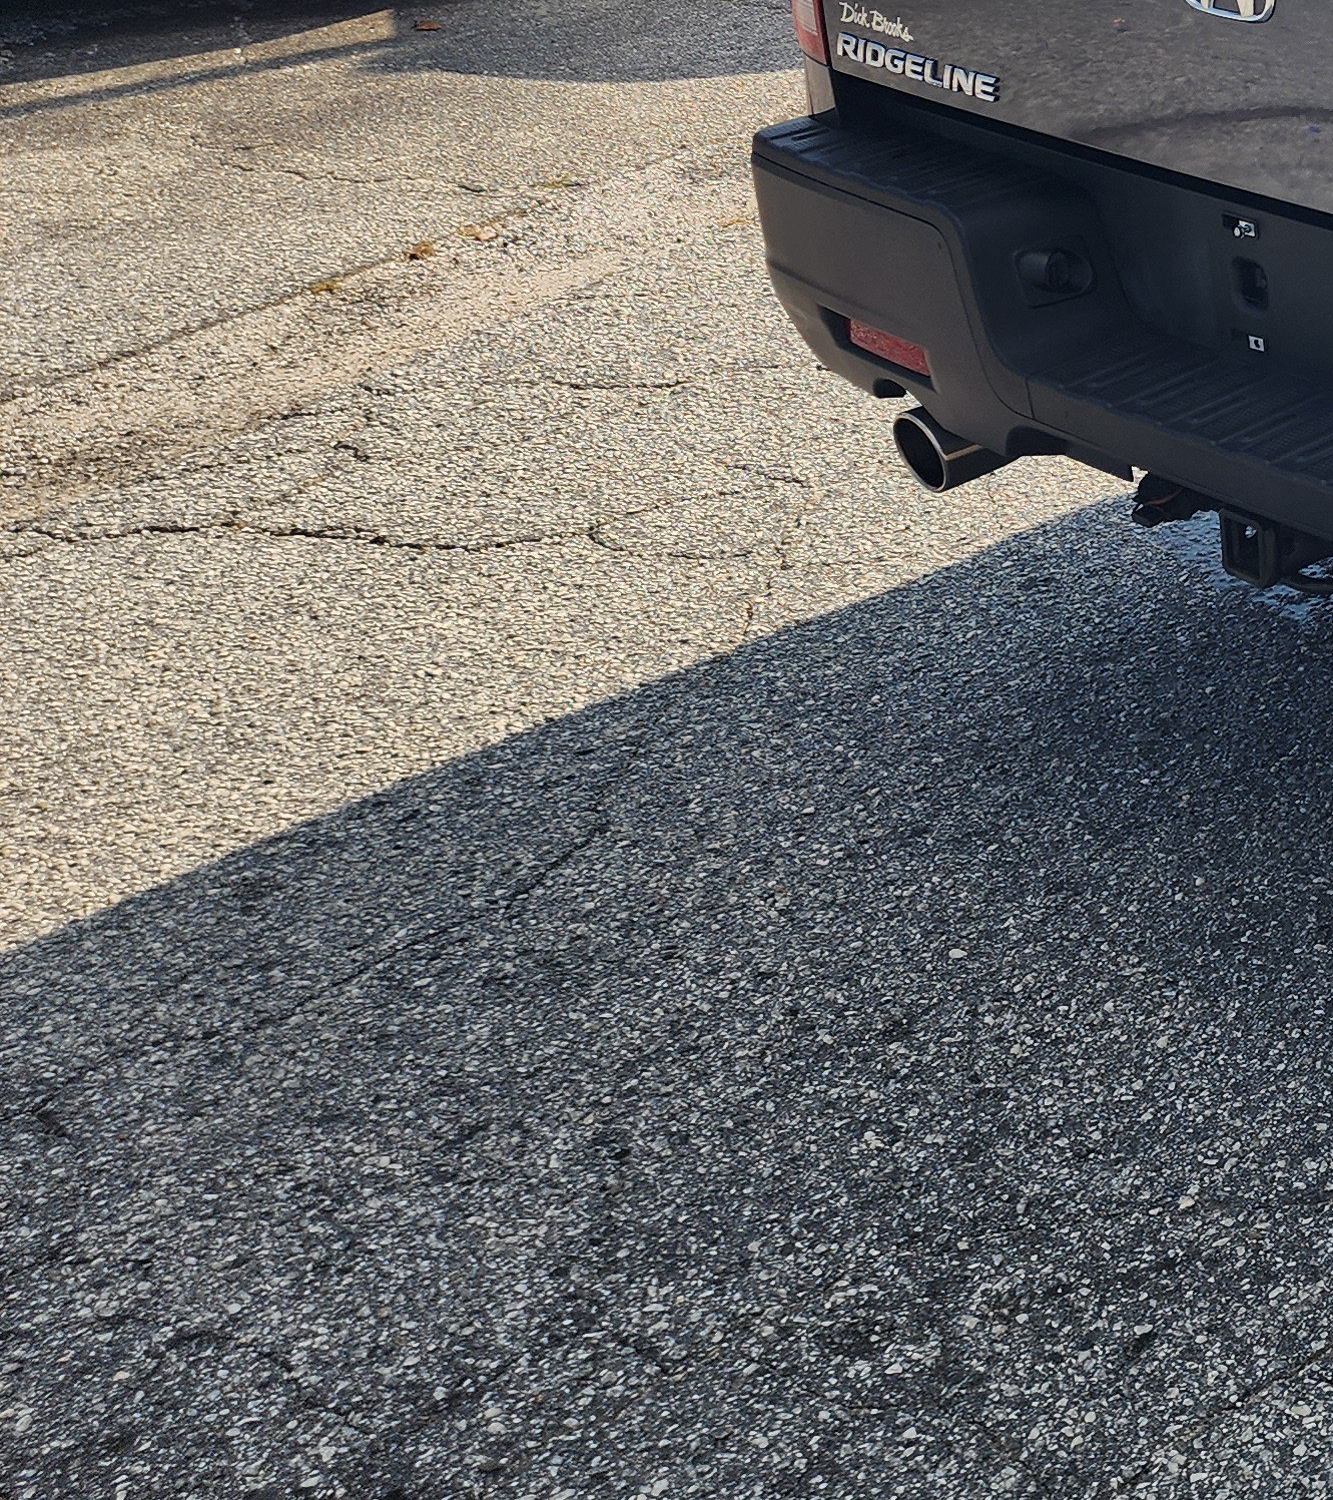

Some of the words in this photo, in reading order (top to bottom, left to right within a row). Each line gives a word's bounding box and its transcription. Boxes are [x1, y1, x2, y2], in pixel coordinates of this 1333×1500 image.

[838, 1, 871, 29] Dick
[870, 10, 915, 42] Brooks
[836, 32, 1000, 102] RIDGELINE
